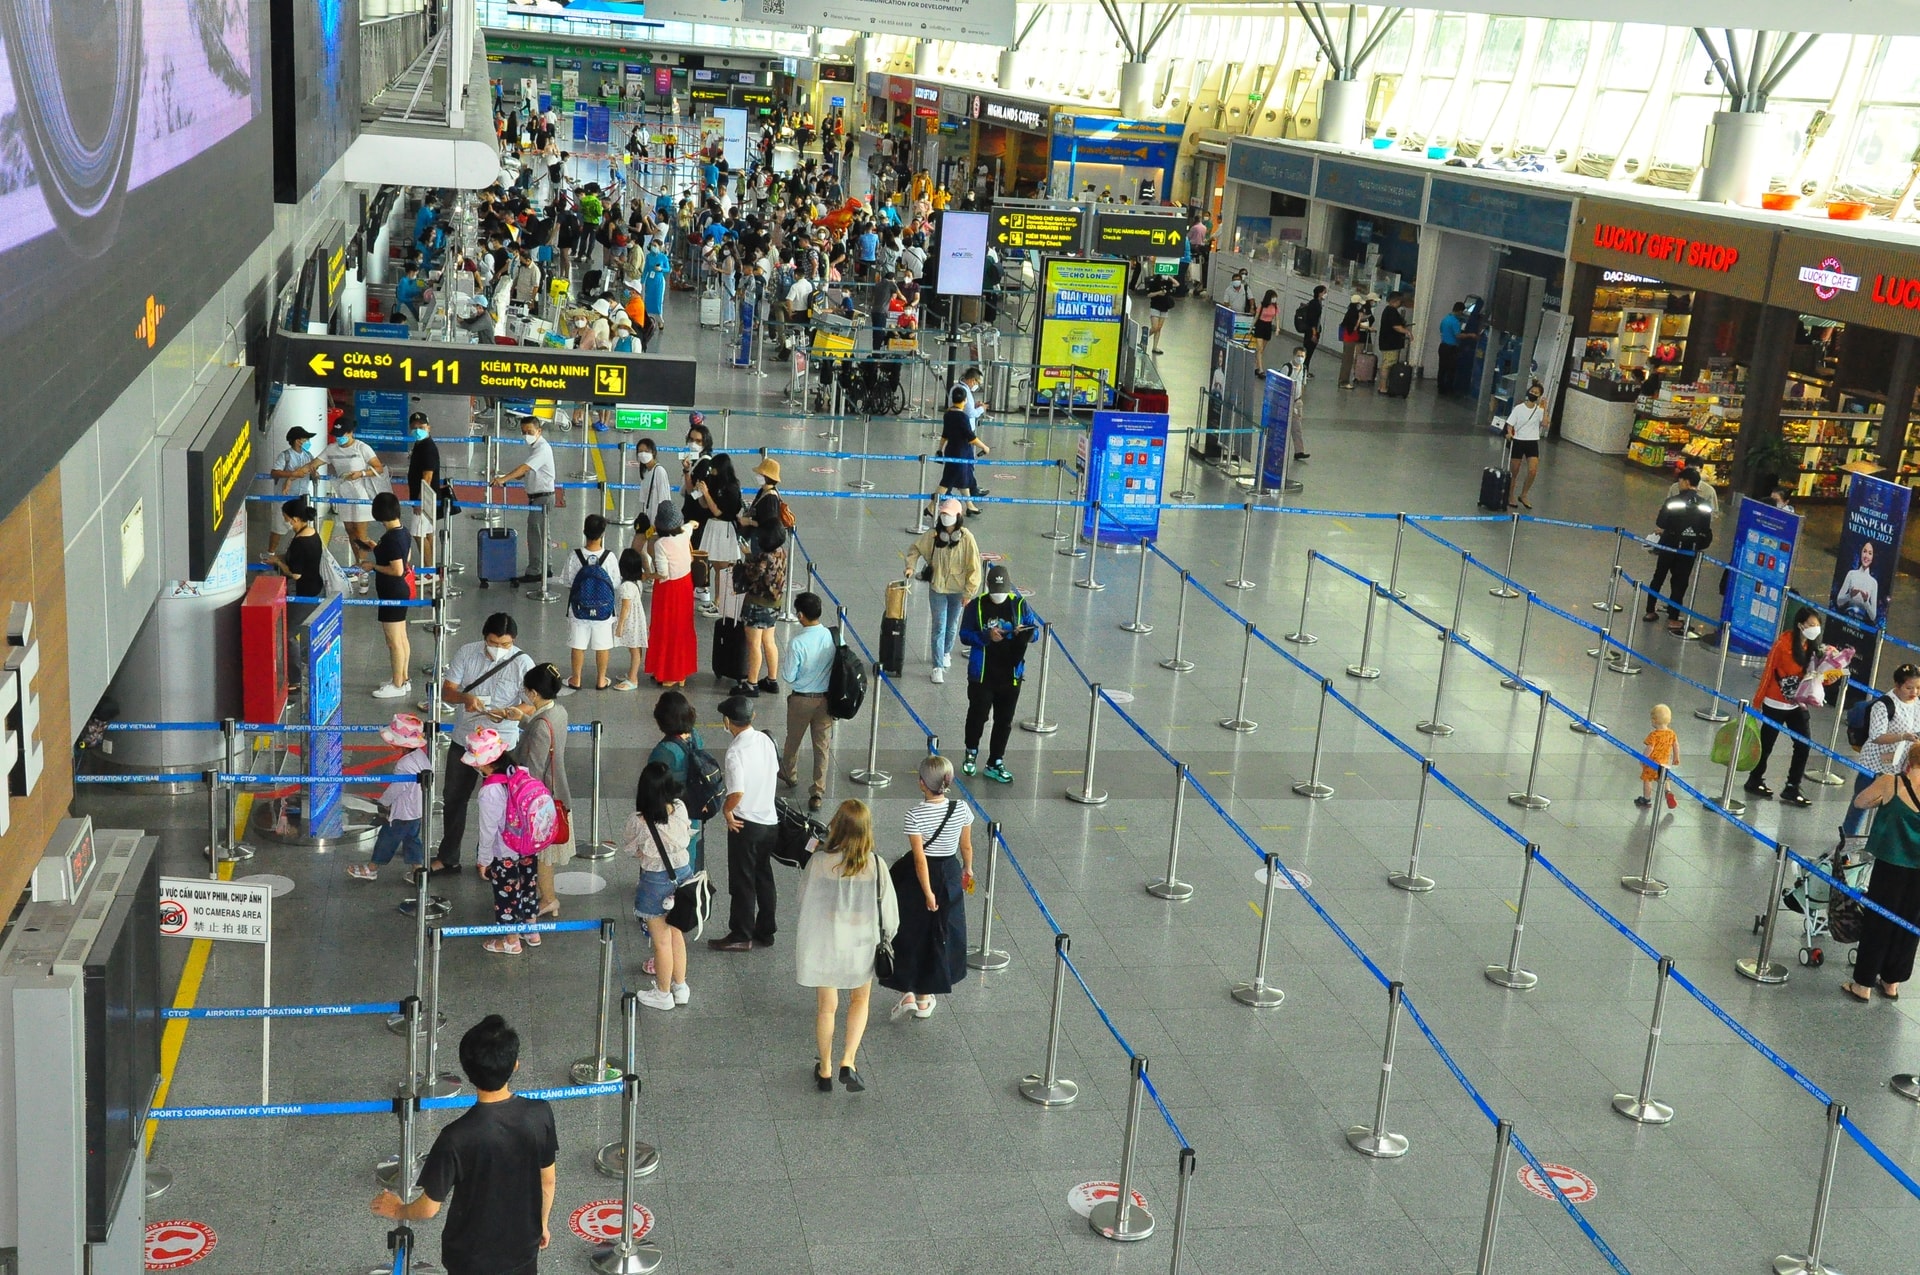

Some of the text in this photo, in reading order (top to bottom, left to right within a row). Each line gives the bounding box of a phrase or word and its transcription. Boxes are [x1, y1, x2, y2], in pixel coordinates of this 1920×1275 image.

[987, 104, 1018, 122] HIGHLANDS
[1593, 223, 1740, 273] LUCKY GIFT SHOP
[1158, 263, 1171, 272] EXIT
[1803, 270, 1852, 289] LUCKY CAFE
[343, 367, 566, 390] Gates Security Check
[514, 362, 540, 374] TRA
[540, 363, 559, 376] AN
[560, 364, 590, 378] NINH
[1850, 511, 1894, 535] MISS PEACE
[1848, 522, 1892, 544] VIETNAM 2022
[179, 886, 193, 899] CẤM
[194, 890, 211, 900] QUAY
[212, 891, 230, 904] PHIM,
[230, 892, 248, 906] CHỤP
[248, 890, 262, 904] ẢNH
[193, 906, 262, 920] NO CAMERAS AREA
[442, 923, 556, 935] RPORTS CORPORATION OF VIETNAM
[205, 1009, 245, 1017] AIRPORTS
[246, 1008, 303, 1016] CORPORATION
[530, 1084, 616, 1099] TY CẢNG HÀNG KHÔNG
[185, 1108, 247, 1117] CORPORATION
[249, 1108, 261, 1116] OF
[262, 1106, 302, 1114] VIETNAM
